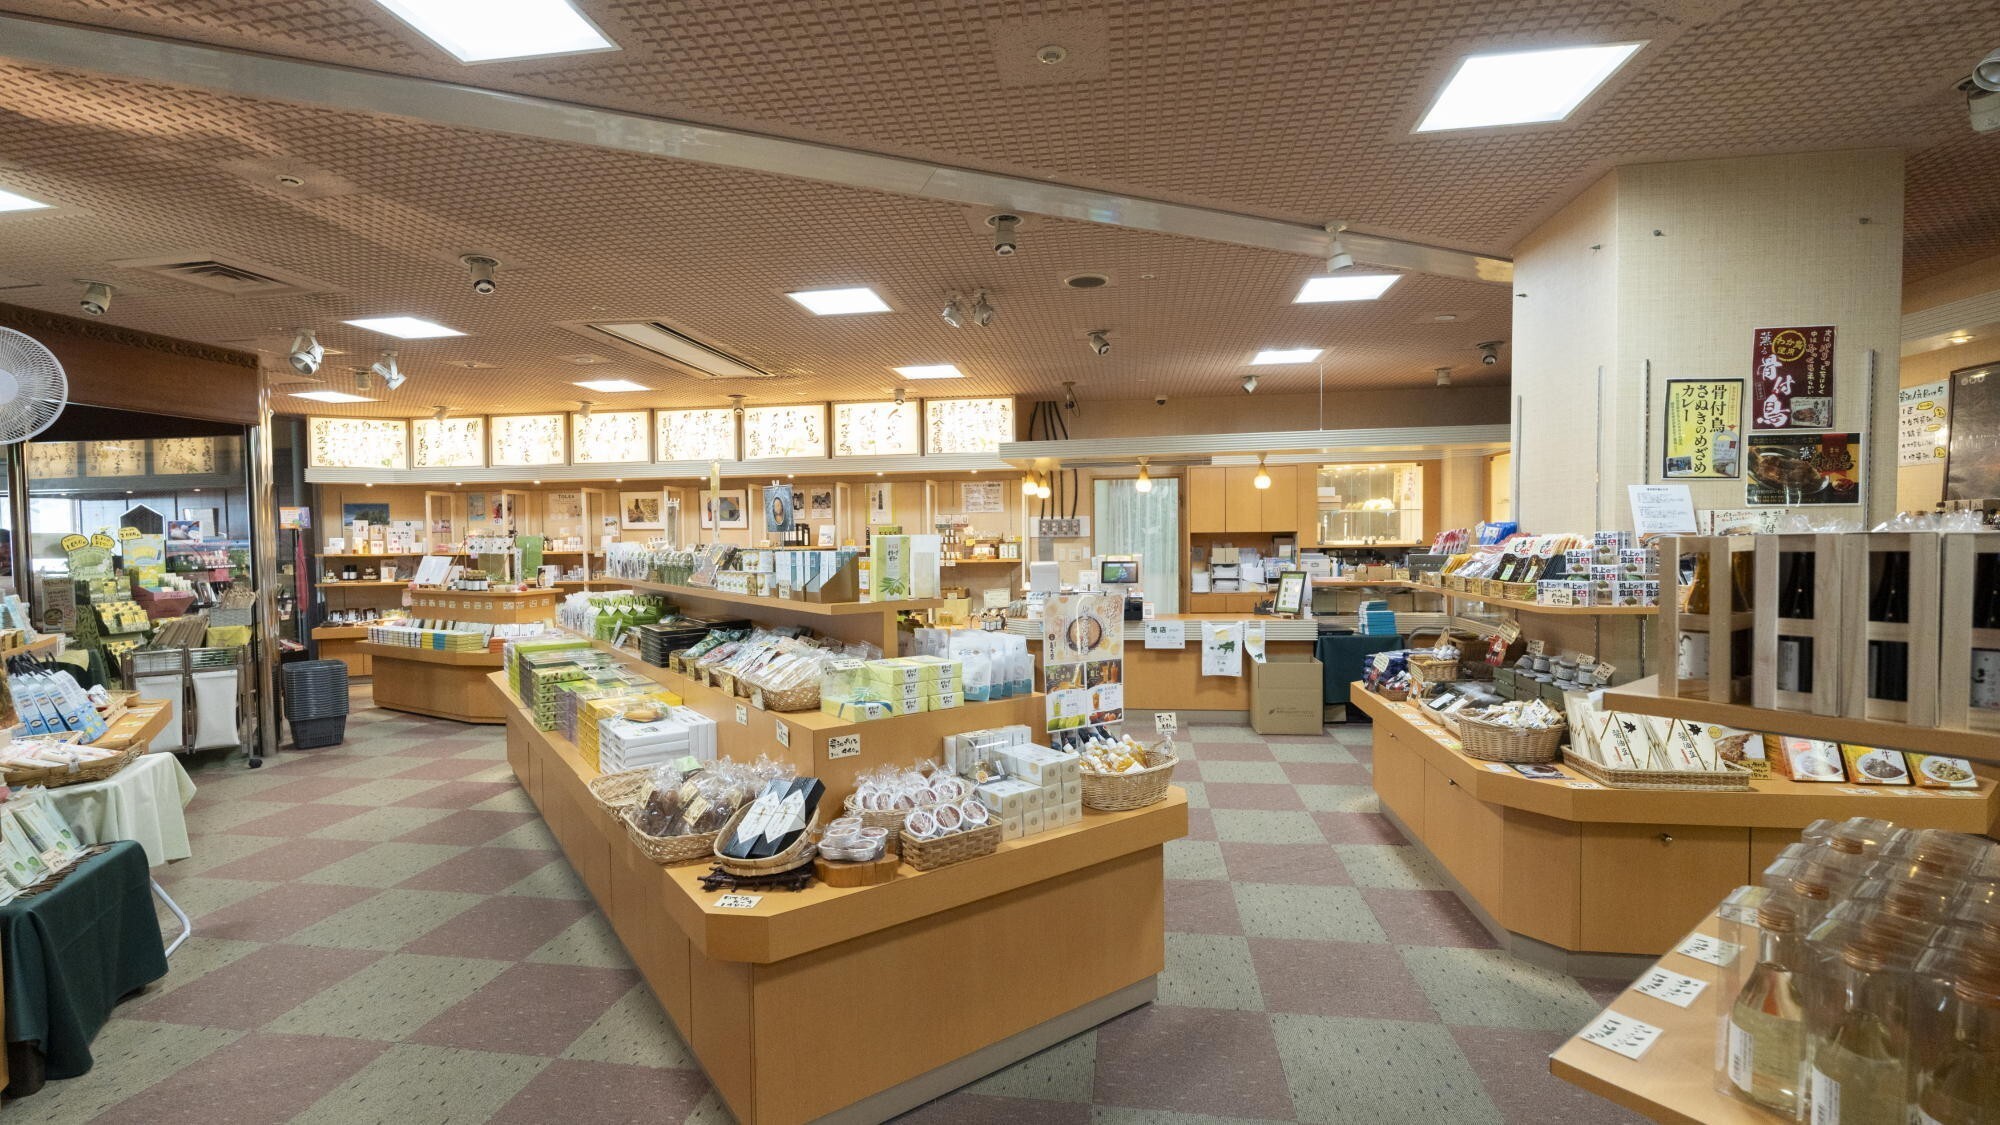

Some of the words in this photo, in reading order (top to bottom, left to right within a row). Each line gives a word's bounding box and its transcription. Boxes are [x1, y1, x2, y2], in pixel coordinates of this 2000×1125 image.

[1682, 384, 1694, 422] カレー
[1710, 384, 1727, 433] 骨付鳥
[1757, 353, 1795, 428] 骨付鳥
[1694, 384, 1708, 474] さぬきのめざめ
